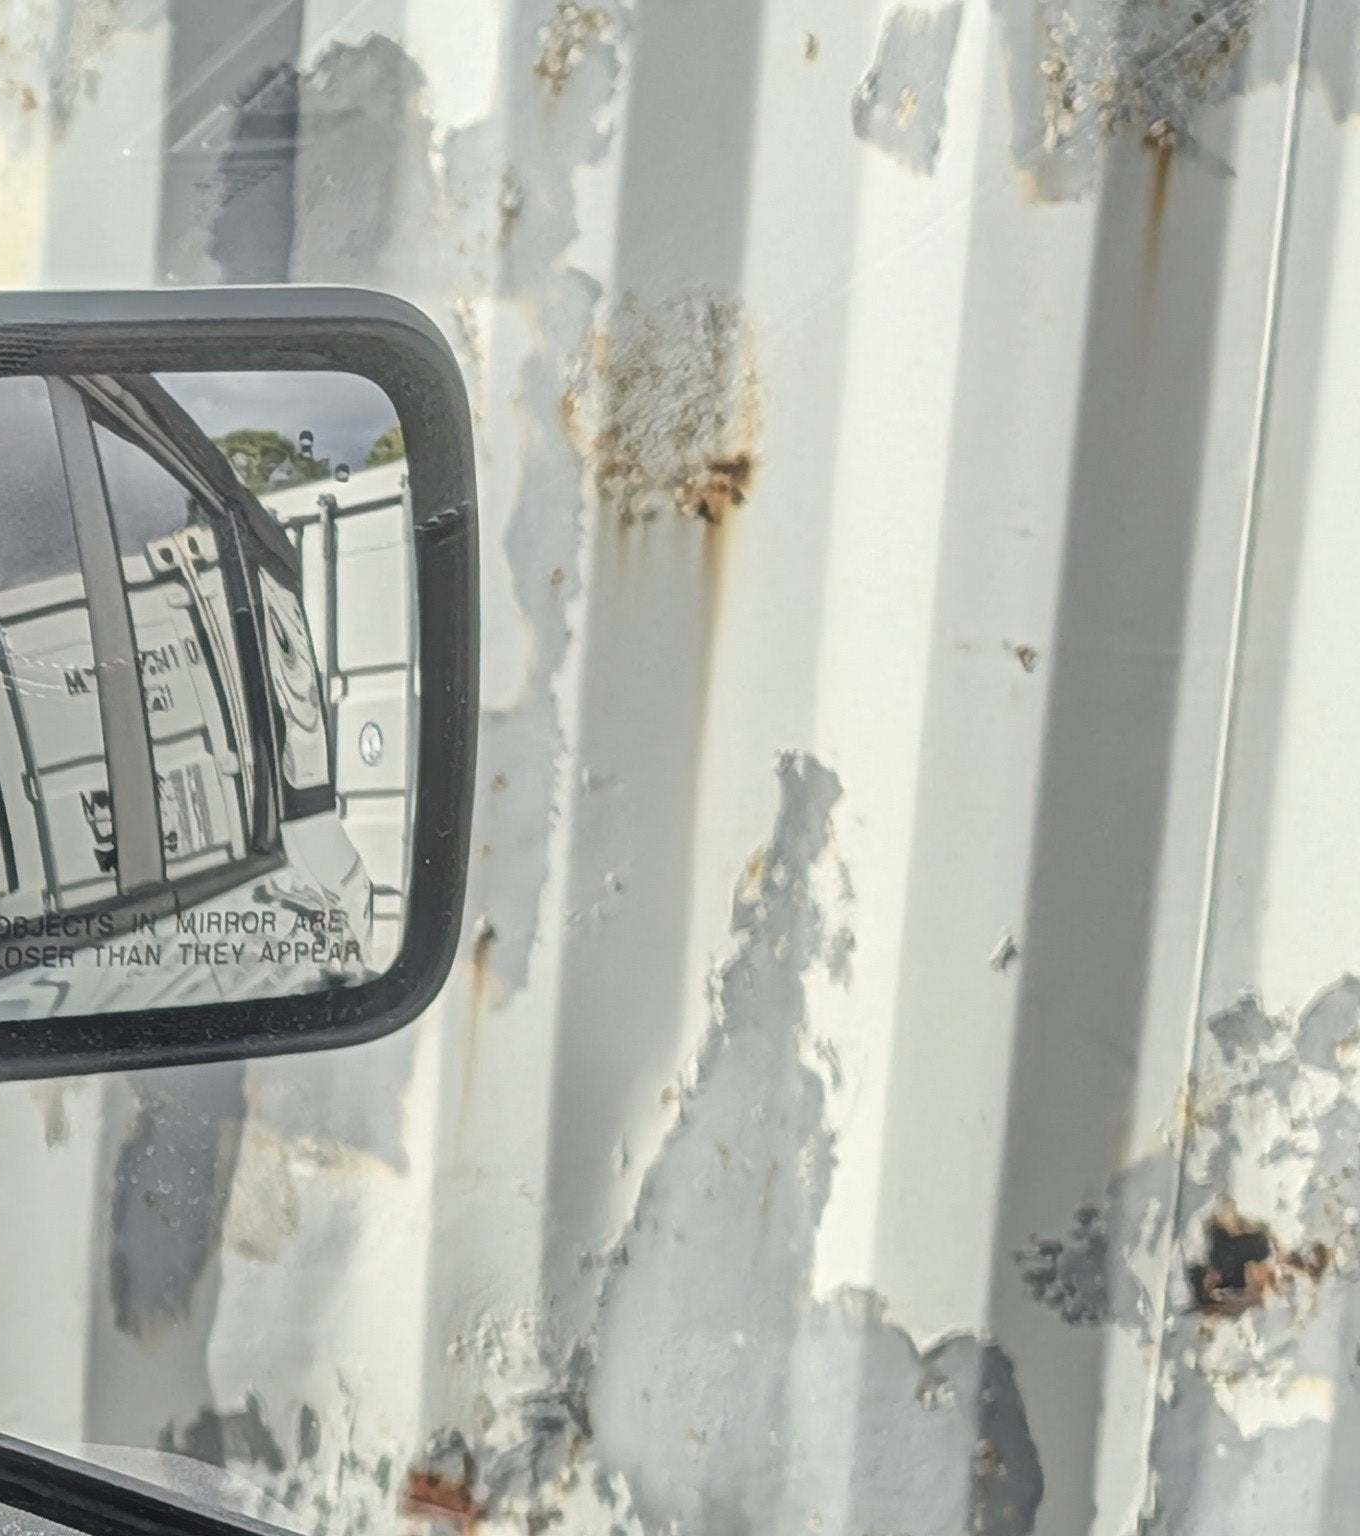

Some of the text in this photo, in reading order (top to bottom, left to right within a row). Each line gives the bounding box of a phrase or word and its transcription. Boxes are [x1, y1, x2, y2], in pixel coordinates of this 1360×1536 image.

[132, 911, 157, 935] IN
[177, 910, 277, 934] MIRROR
[295, 909, 344, 933] ARE
[93, 944, 161, 967] THAN
[181, 941, 245, 965] THEY
[259, 940, 361, 963] APPEAR
